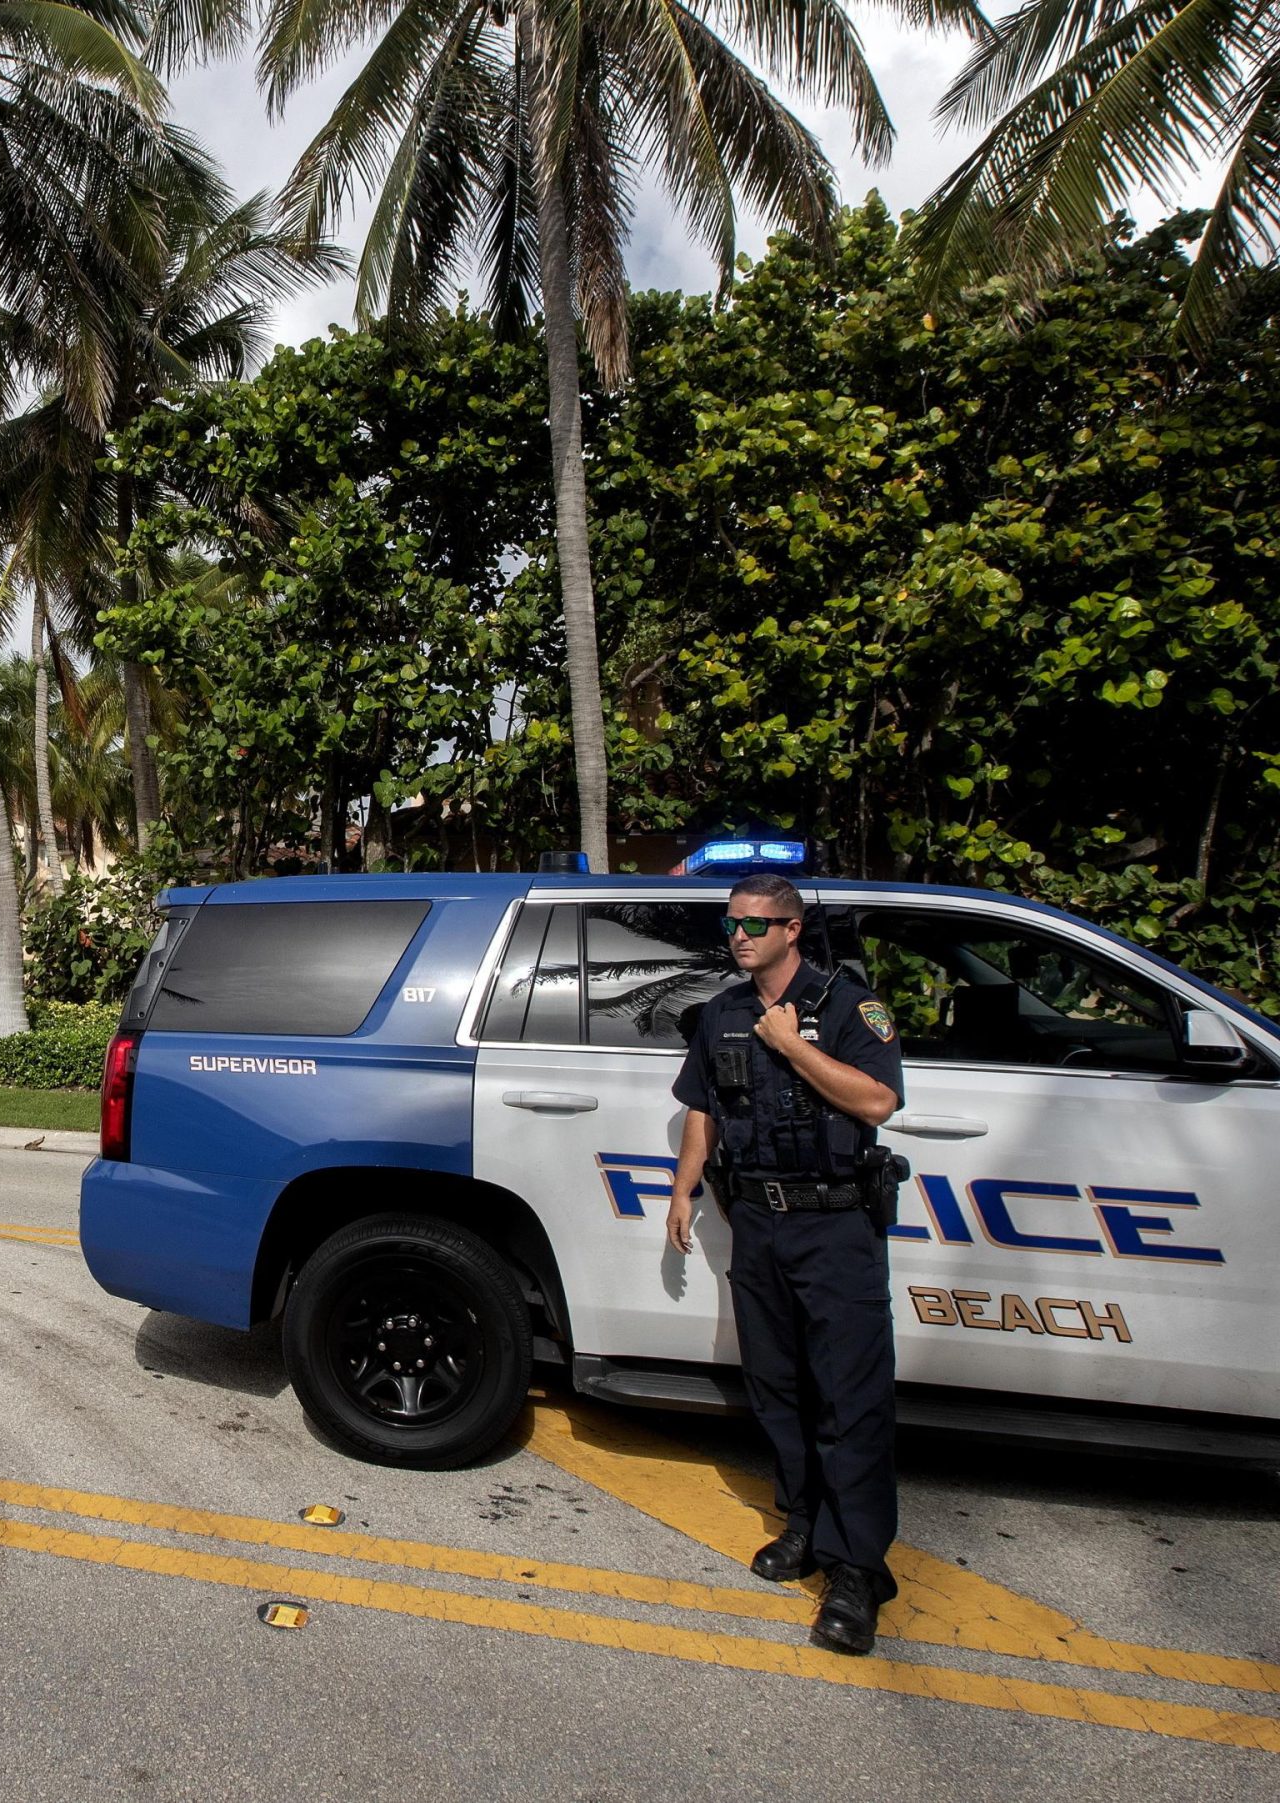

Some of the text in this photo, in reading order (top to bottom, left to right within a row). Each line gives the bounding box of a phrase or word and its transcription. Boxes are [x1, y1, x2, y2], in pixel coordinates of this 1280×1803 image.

[402, 986, 437, 1003] 817
[189, 1055, 317, 1075] SUPERVISOR
[593, 1151, 1227, 1267] PICE
[907, 1285, 1134, 1344] BEACH
